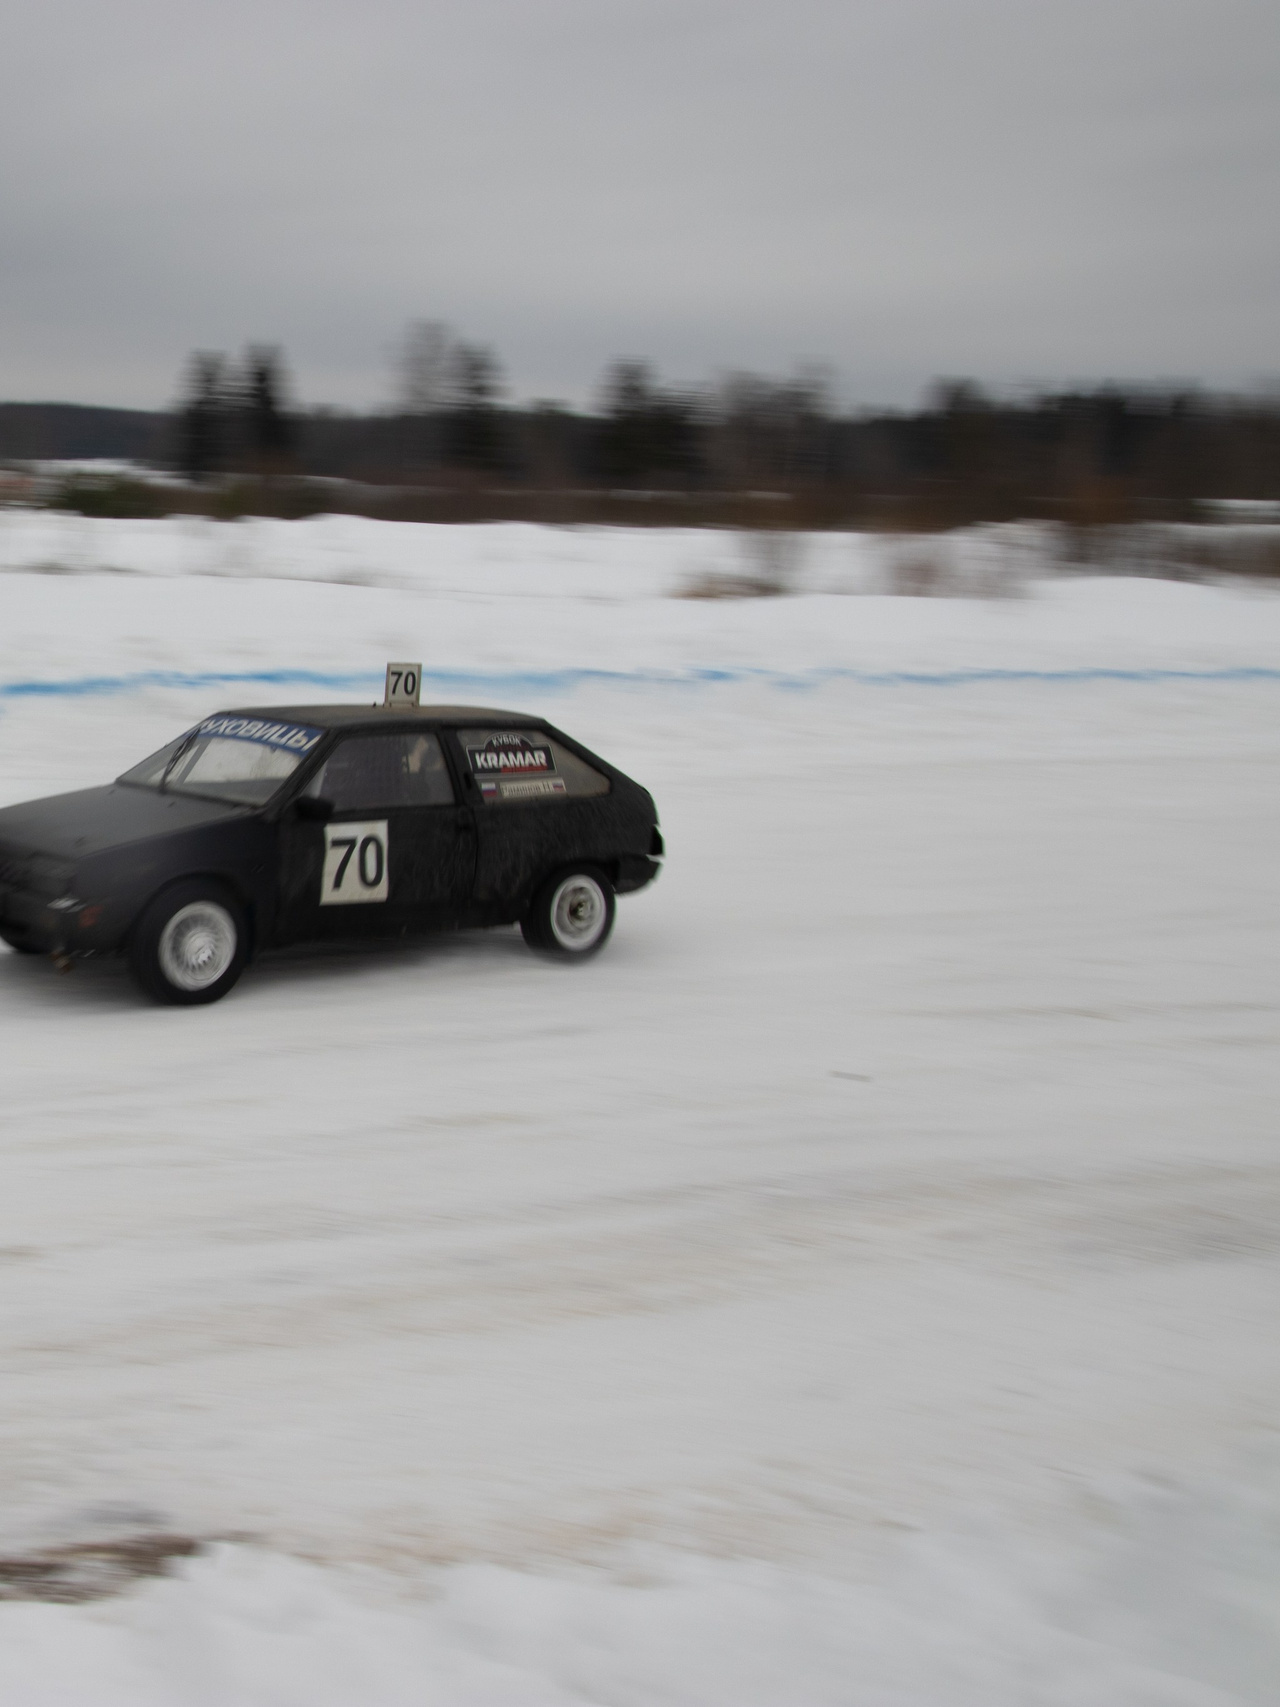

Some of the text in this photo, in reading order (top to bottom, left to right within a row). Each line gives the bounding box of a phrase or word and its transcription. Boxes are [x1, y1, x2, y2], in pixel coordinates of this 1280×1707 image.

[390, 670, 417, 696] 70
[475, 750, 548, 769] KRAMAR
[329, 834, 384, 891] 70
